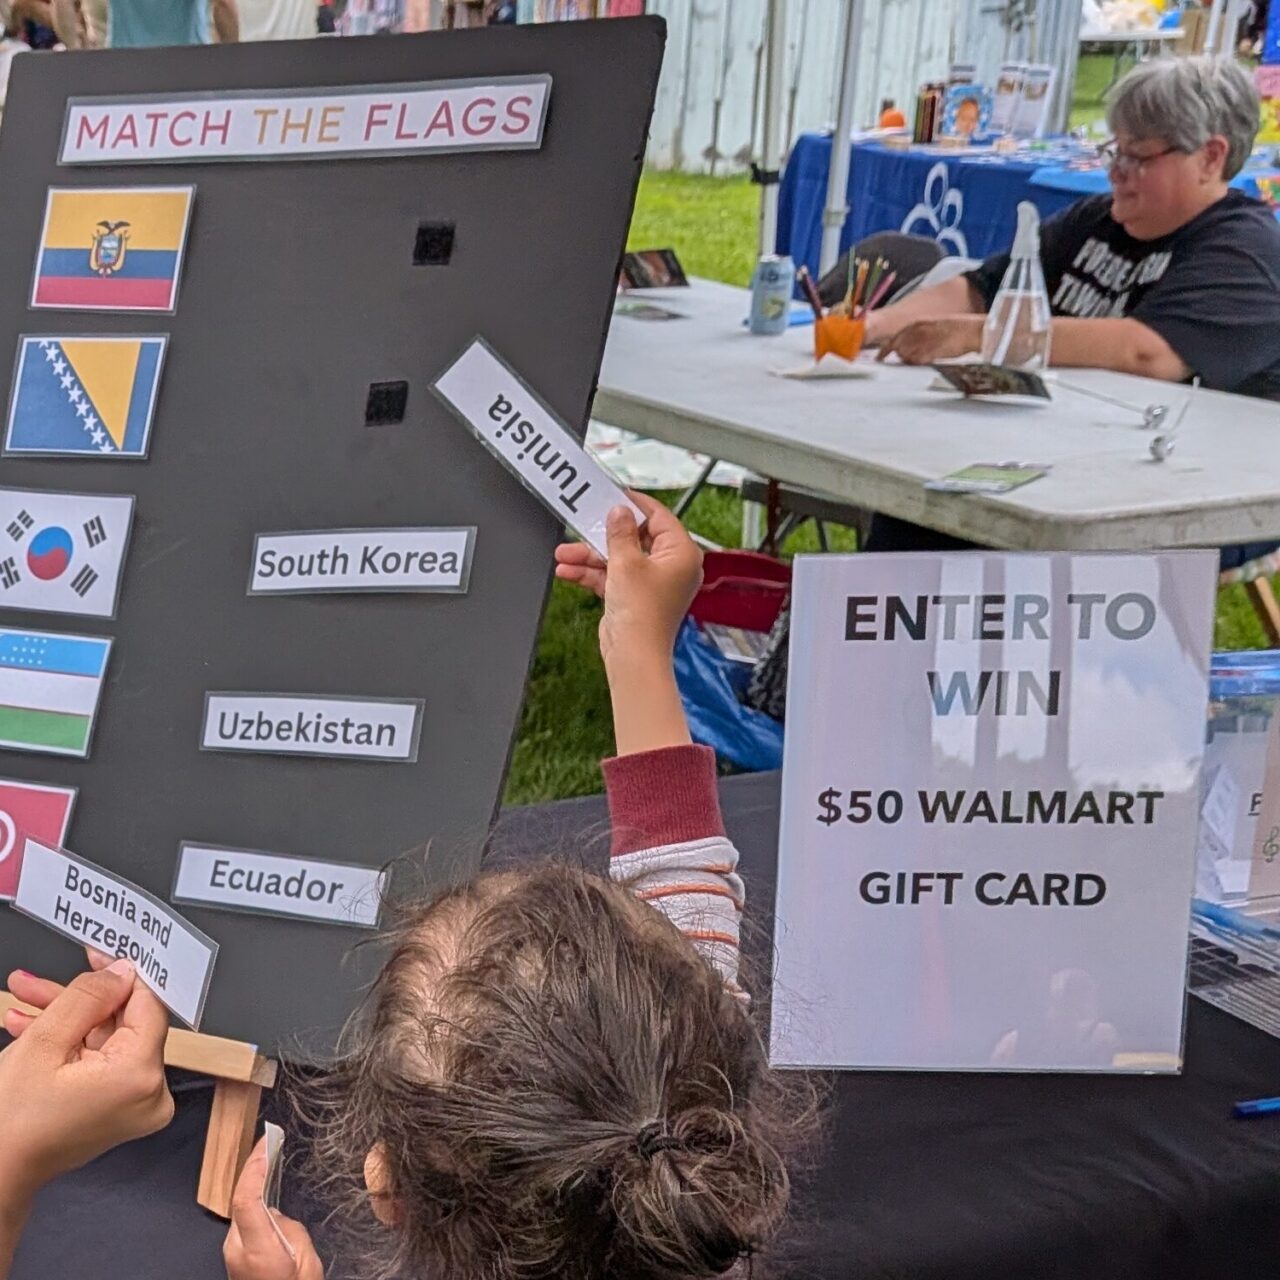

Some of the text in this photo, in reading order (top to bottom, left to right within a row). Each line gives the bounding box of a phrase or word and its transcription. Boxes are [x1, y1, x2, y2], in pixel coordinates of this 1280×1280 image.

[75, 96, 533, 150] MATCH THE FLAGS
[488, 393, 591, 514] Tunisia
[257, 545, 458, 578] South Korea
[844, 592, 1157, 641] ENTER TO
[926, 670, 1061, 716] WIN
[218, 711, 396, 747] Uzbekistan
[816, 787, 1165, 827] $50 WALMART
[209, 859, 344, 904] Ecuador
[859, 871, 1107, 906] GIFT CARD
[64, 864, 172, 949] Bosnia and
[54, 895, 168, 991] Herzegovina
